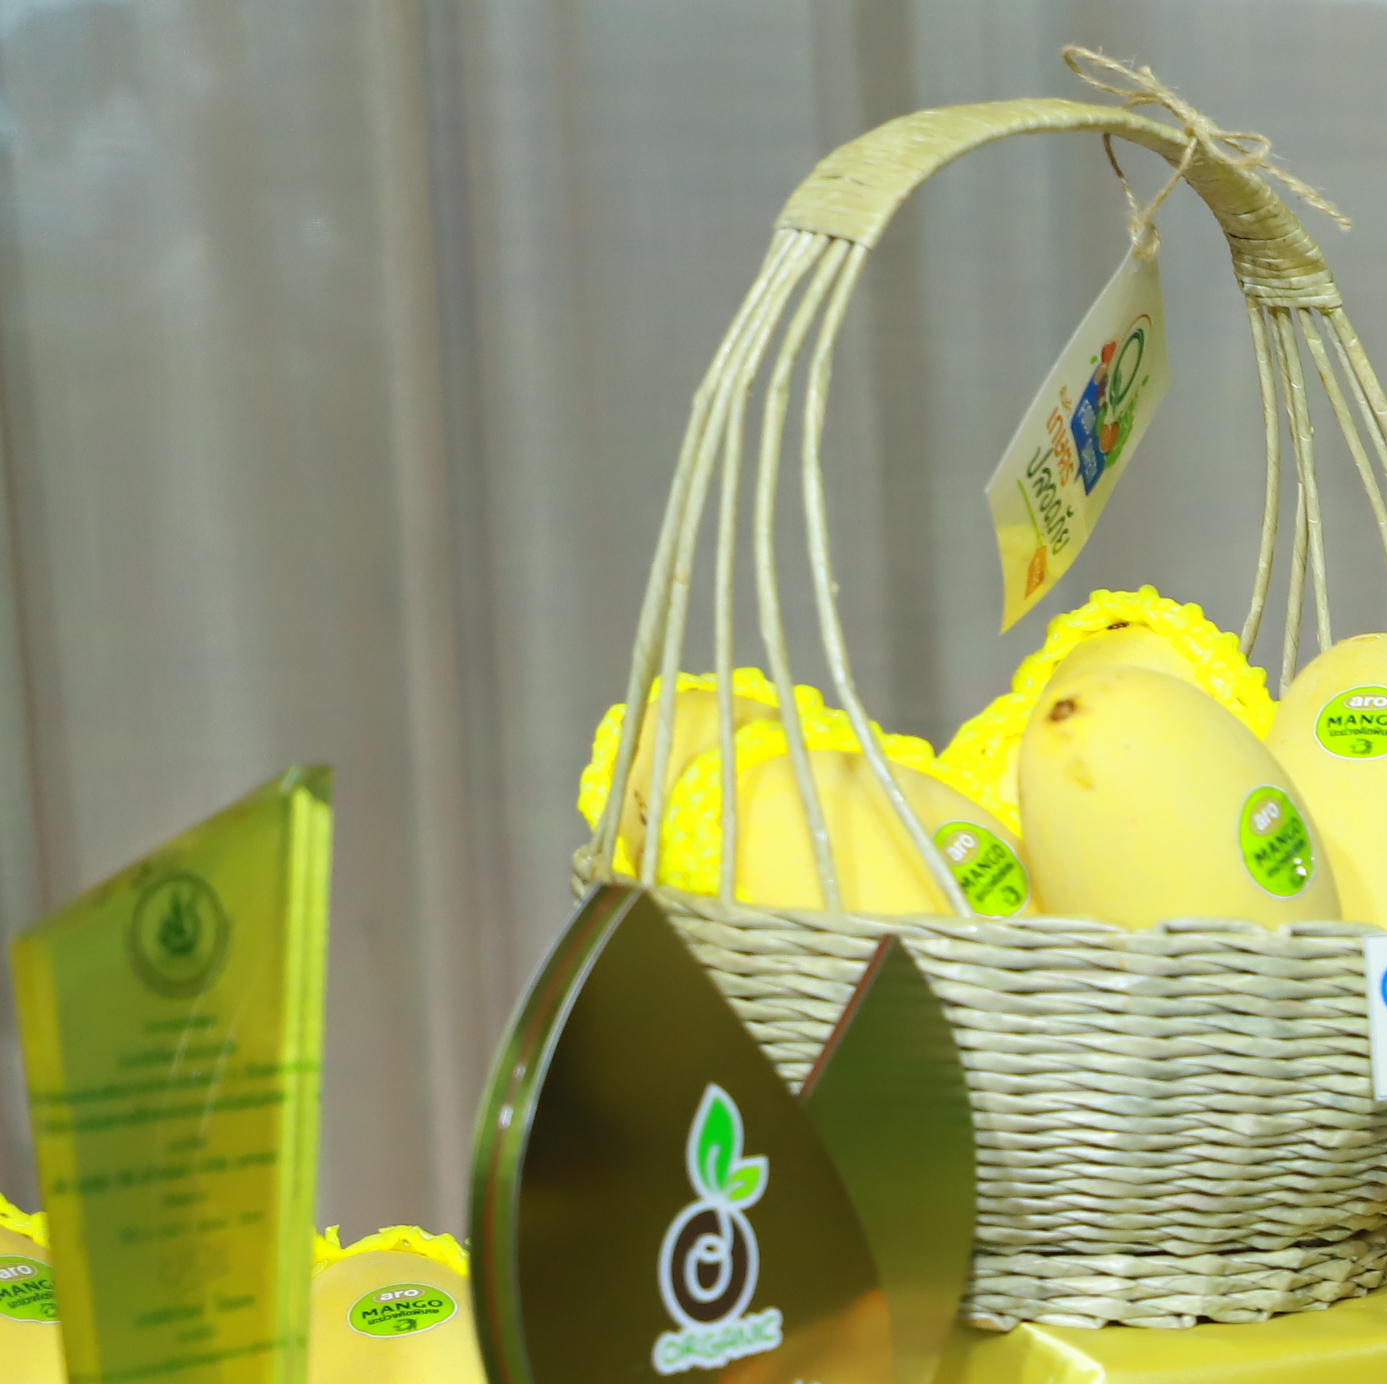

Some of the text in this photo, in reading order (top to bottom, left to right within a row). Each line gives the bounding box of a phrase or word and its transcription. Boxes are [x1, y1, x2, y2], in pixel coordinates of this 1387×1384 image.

[945, 834, 976, 862] aro
[380, 1289, 419, 1301] aro
[361, 1299, 444, 1320] MANGO
[656, 1310, 781, 1372] ORGANIC
